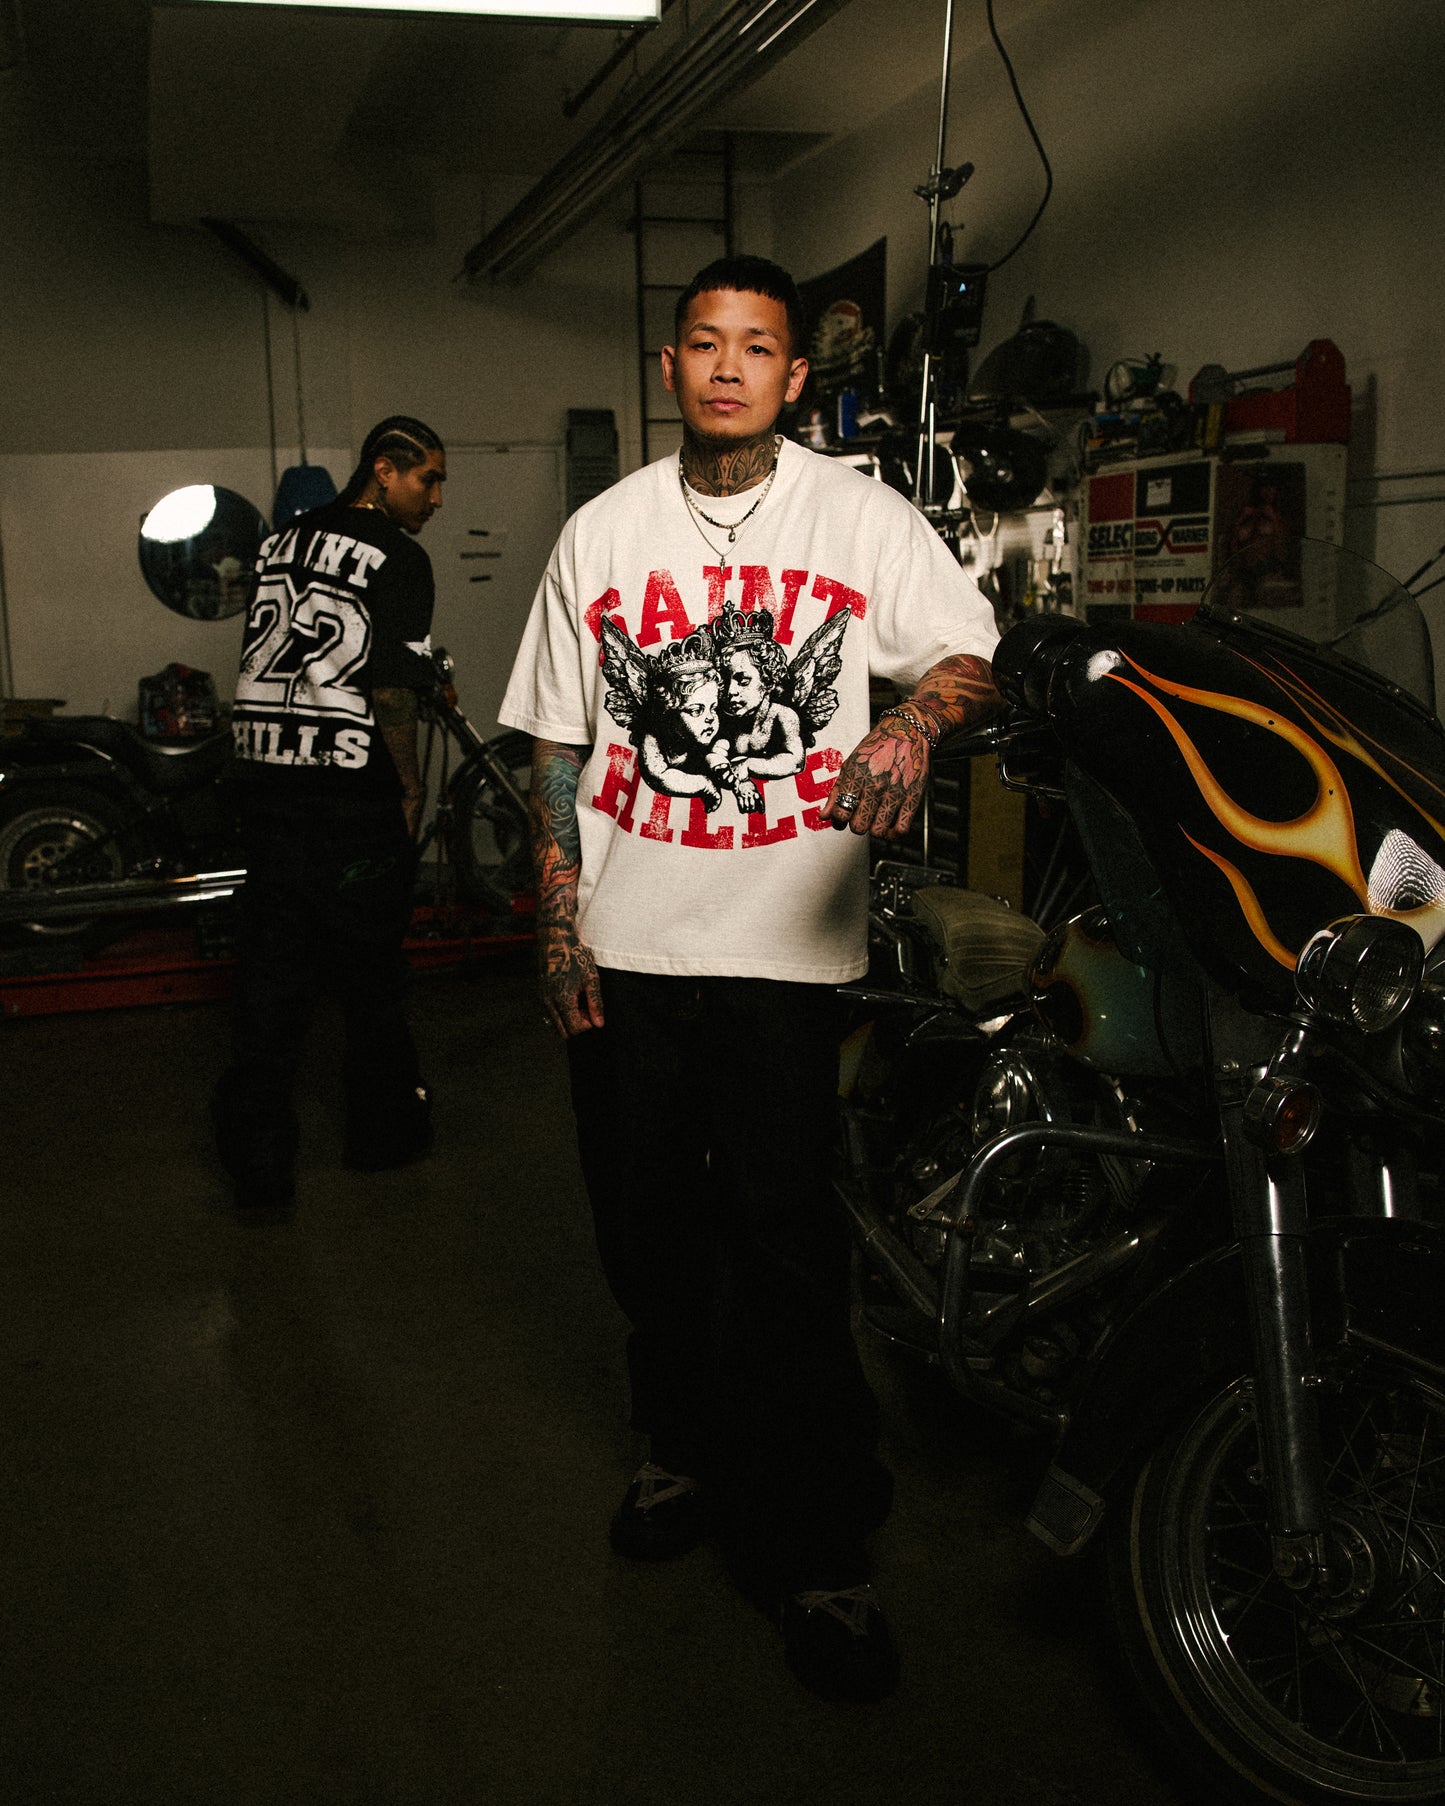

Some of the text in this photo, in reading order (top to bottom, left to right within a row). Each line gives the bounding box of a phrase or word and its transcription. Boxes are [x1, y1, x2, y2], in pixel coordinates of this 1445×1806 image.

[584, 565, 867, 667] SAINT
[1176, 577, 1205, 593] PARTS
[233, 573, 375, 727] 22
[231, 720, 371, 770] HILLS
[592, 743, 843, 850] HILLS
